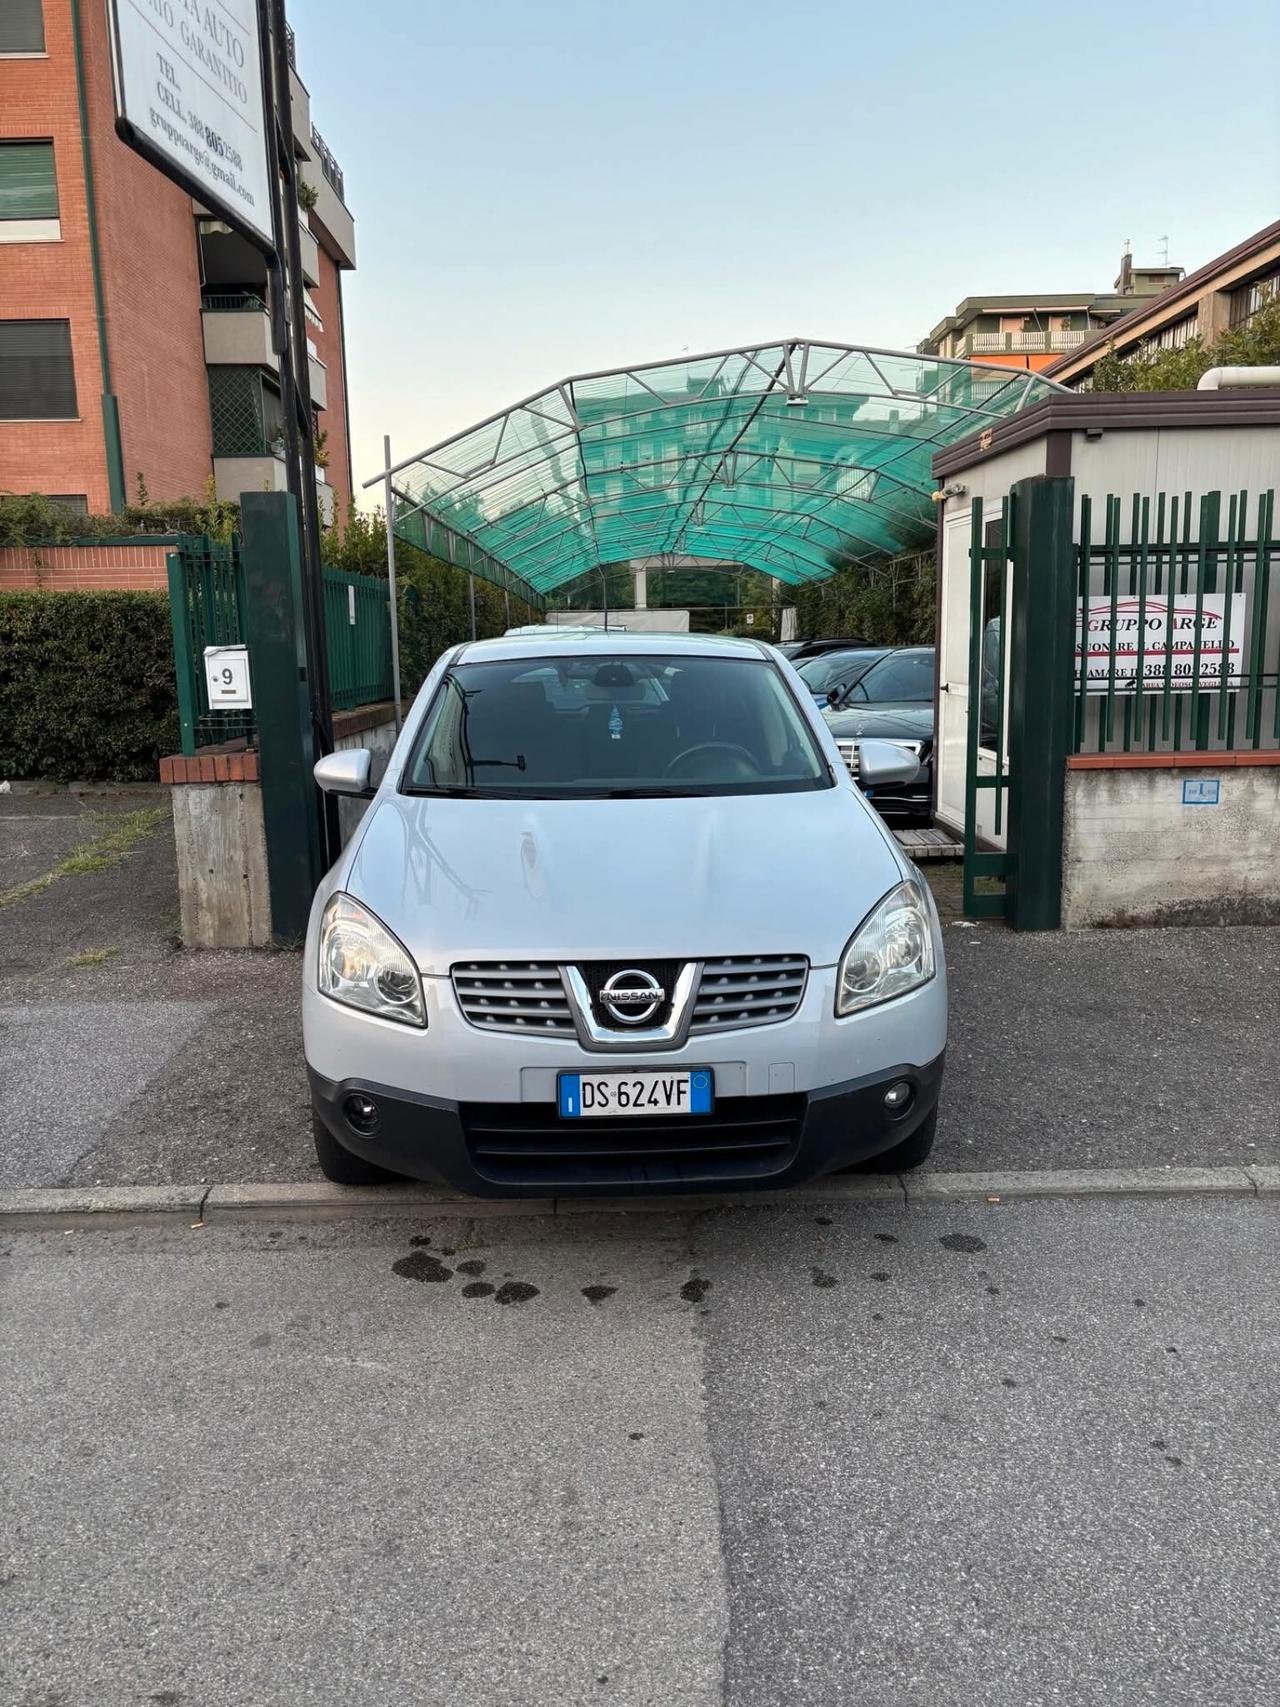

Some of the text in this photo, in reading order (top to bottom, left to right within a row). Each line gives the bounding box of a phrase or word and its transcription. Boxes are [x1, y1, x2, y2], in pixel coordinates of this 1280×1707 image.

[204, 8, 243, 68] AUTO
[181, 21, 247, 104] GARANTITO
[1076, 642, 1134, 652] SONRE
[1152, 640, 1235, 650] CAMPAELLO
[222, 668, 233, 685] 9
[607, 991, 658, 1001] NISSAN
